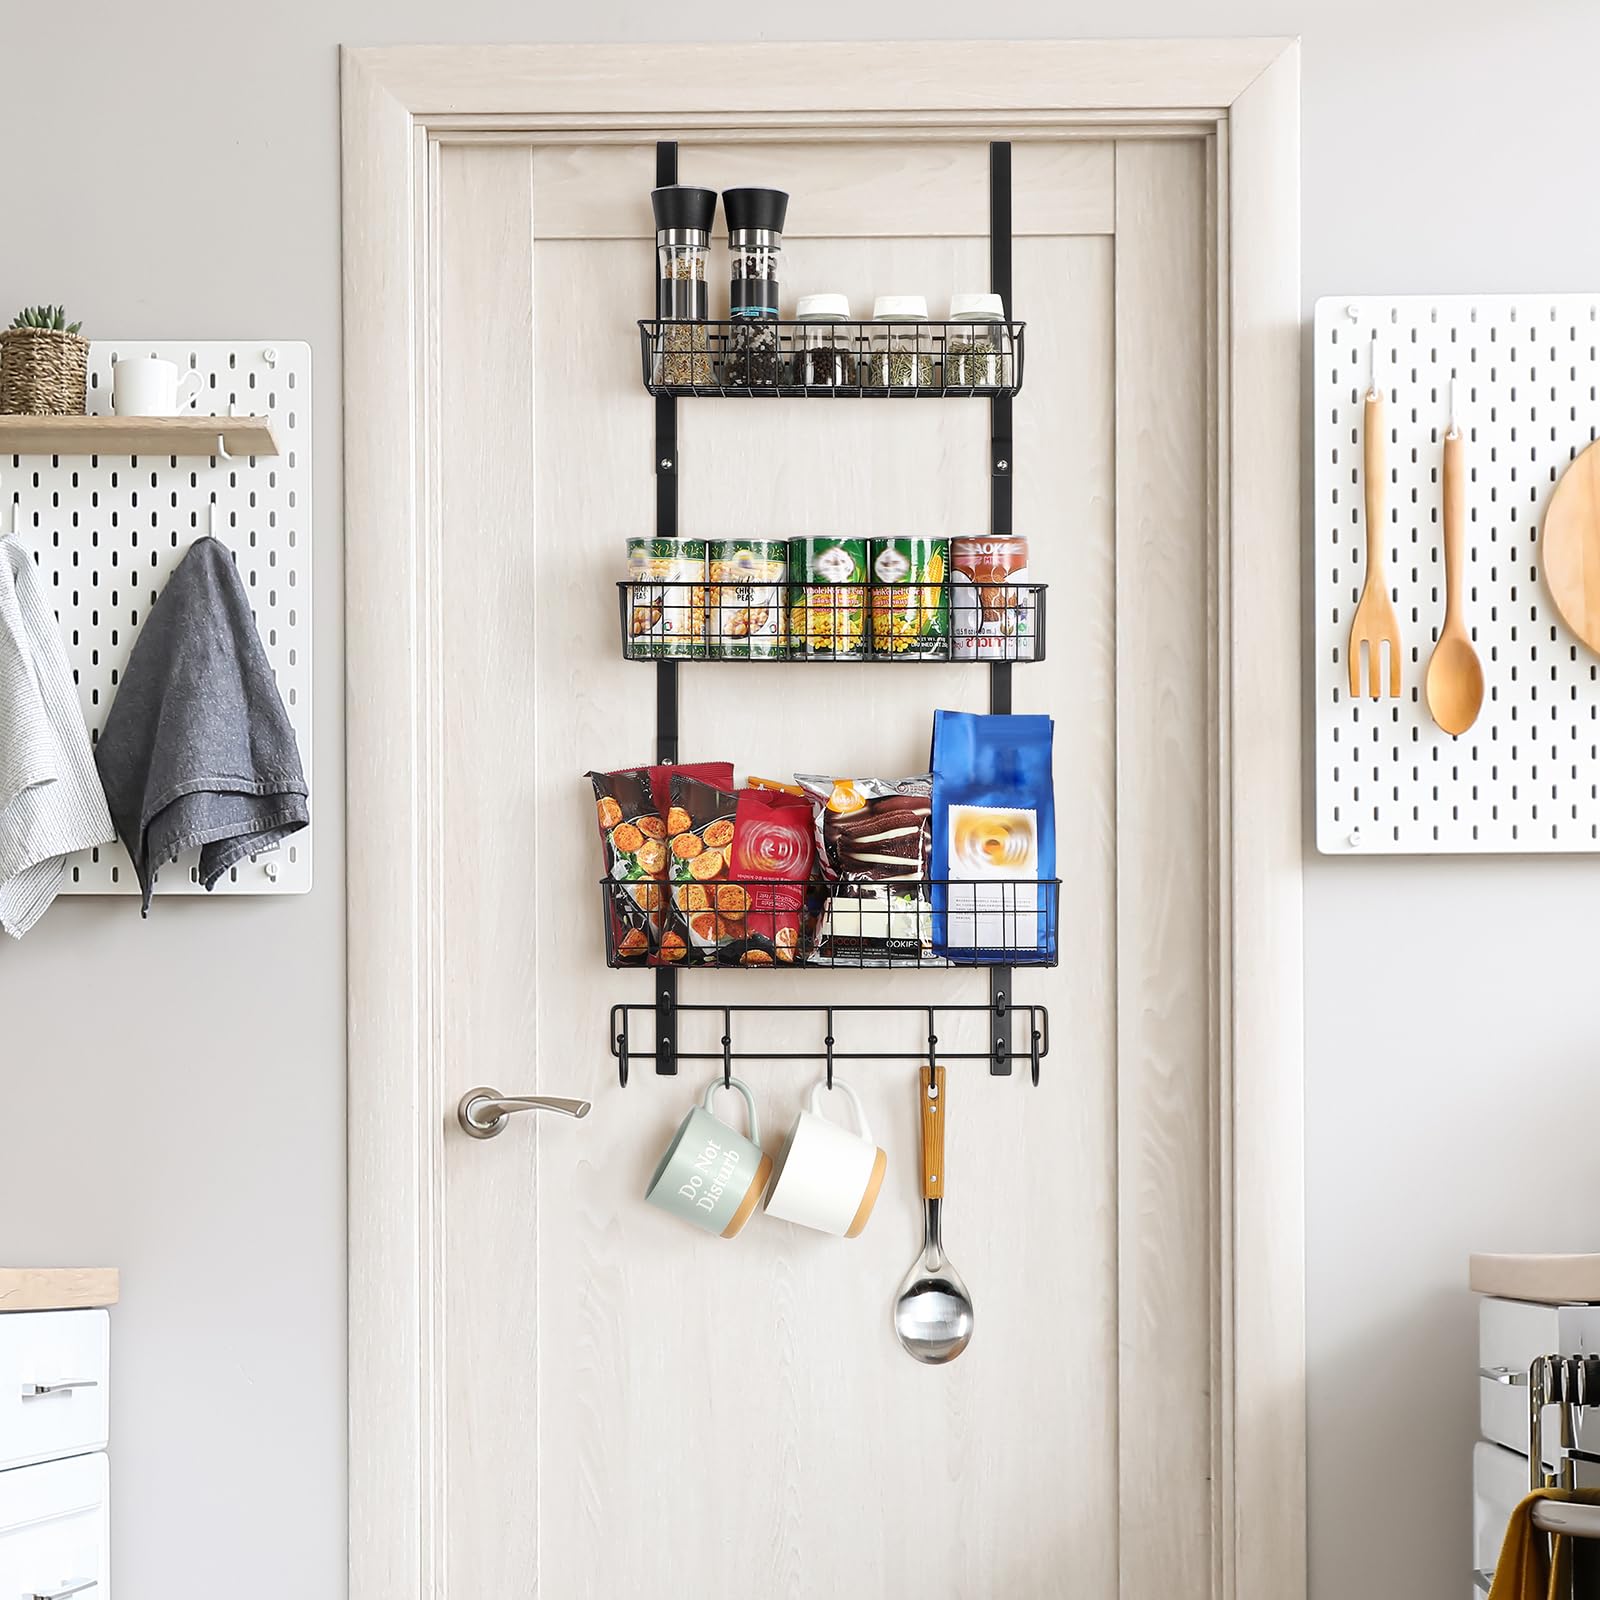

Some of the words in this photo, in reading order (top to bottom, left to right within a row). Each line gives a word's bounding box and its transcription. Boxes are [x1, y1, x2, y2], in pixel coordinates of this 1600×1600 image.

[677, 1175, 702, 1200] Do
[695, 1139, 721, 1176] Not
[696, 1149, 740, 1213] Disturb
